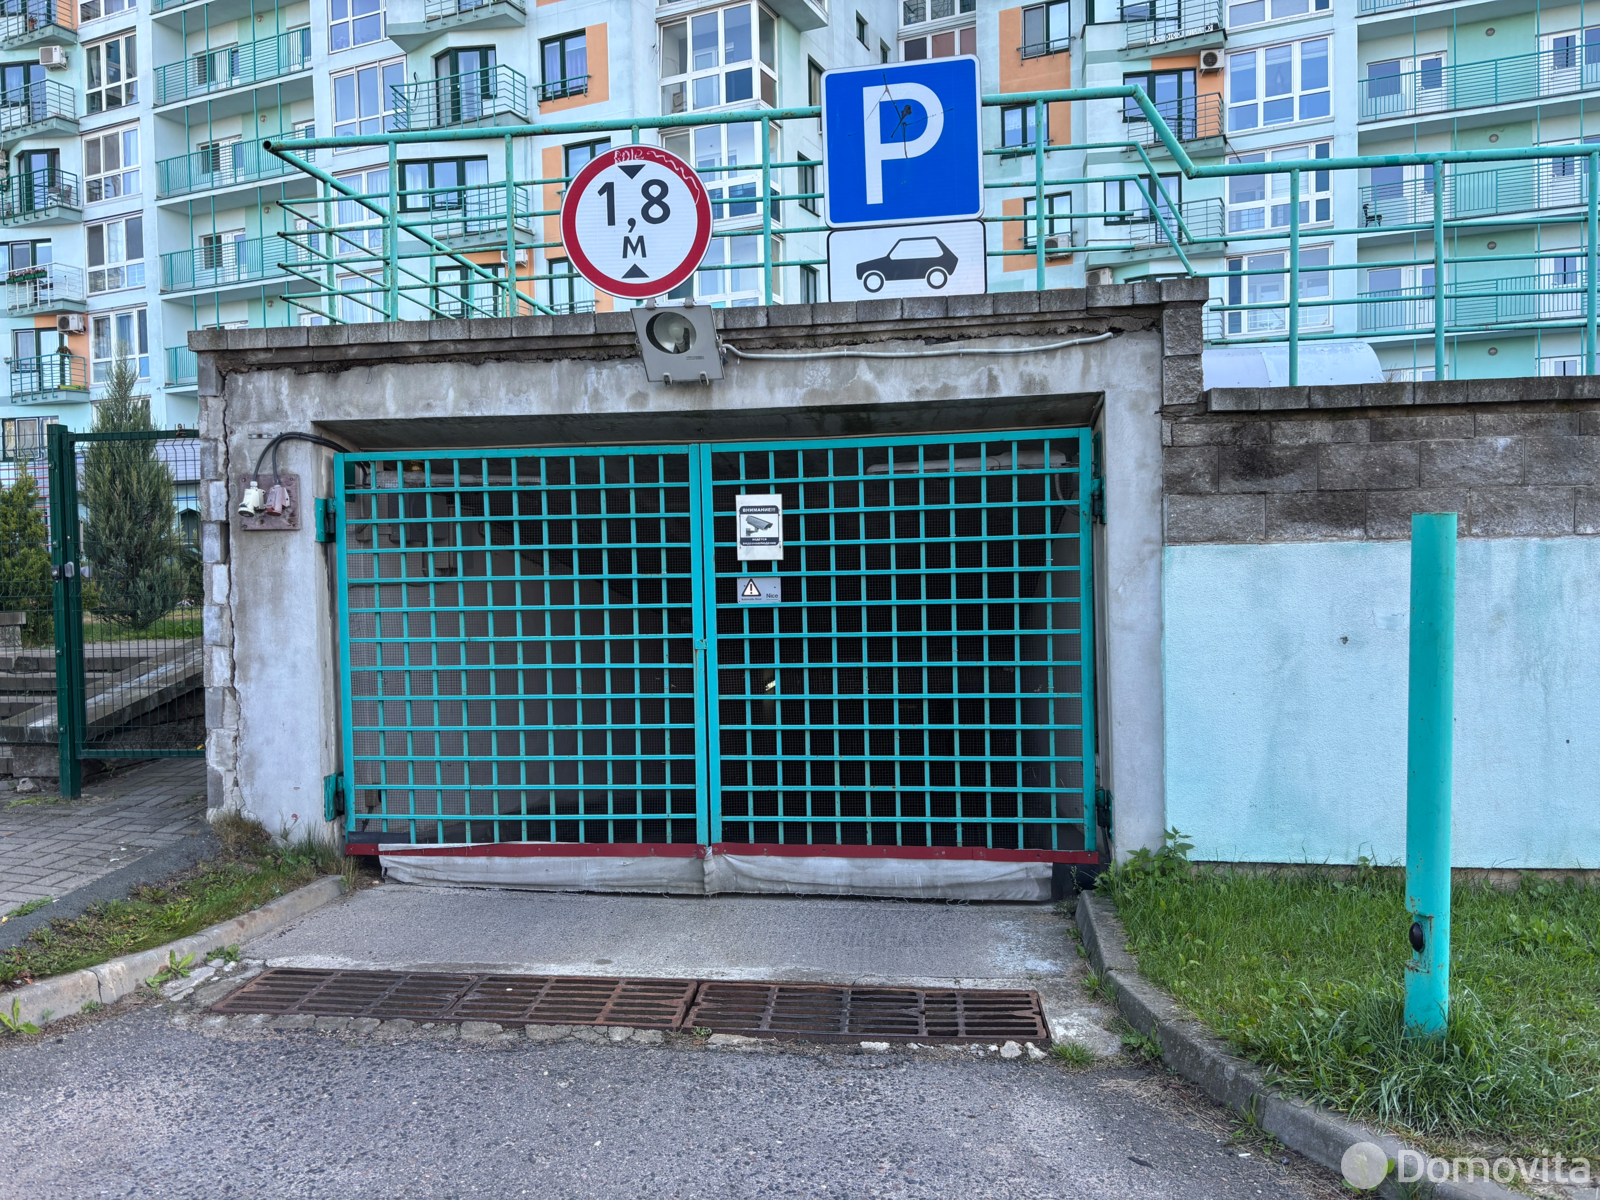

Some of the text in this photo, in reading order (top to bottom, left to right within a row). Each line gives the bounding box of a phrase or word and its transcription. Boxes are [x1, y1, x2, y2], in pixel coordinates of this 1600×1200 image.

[862, 82, 945, 205] P
[597, 178, 671, 233] 1,8
[622, 235, 647, 259] М
